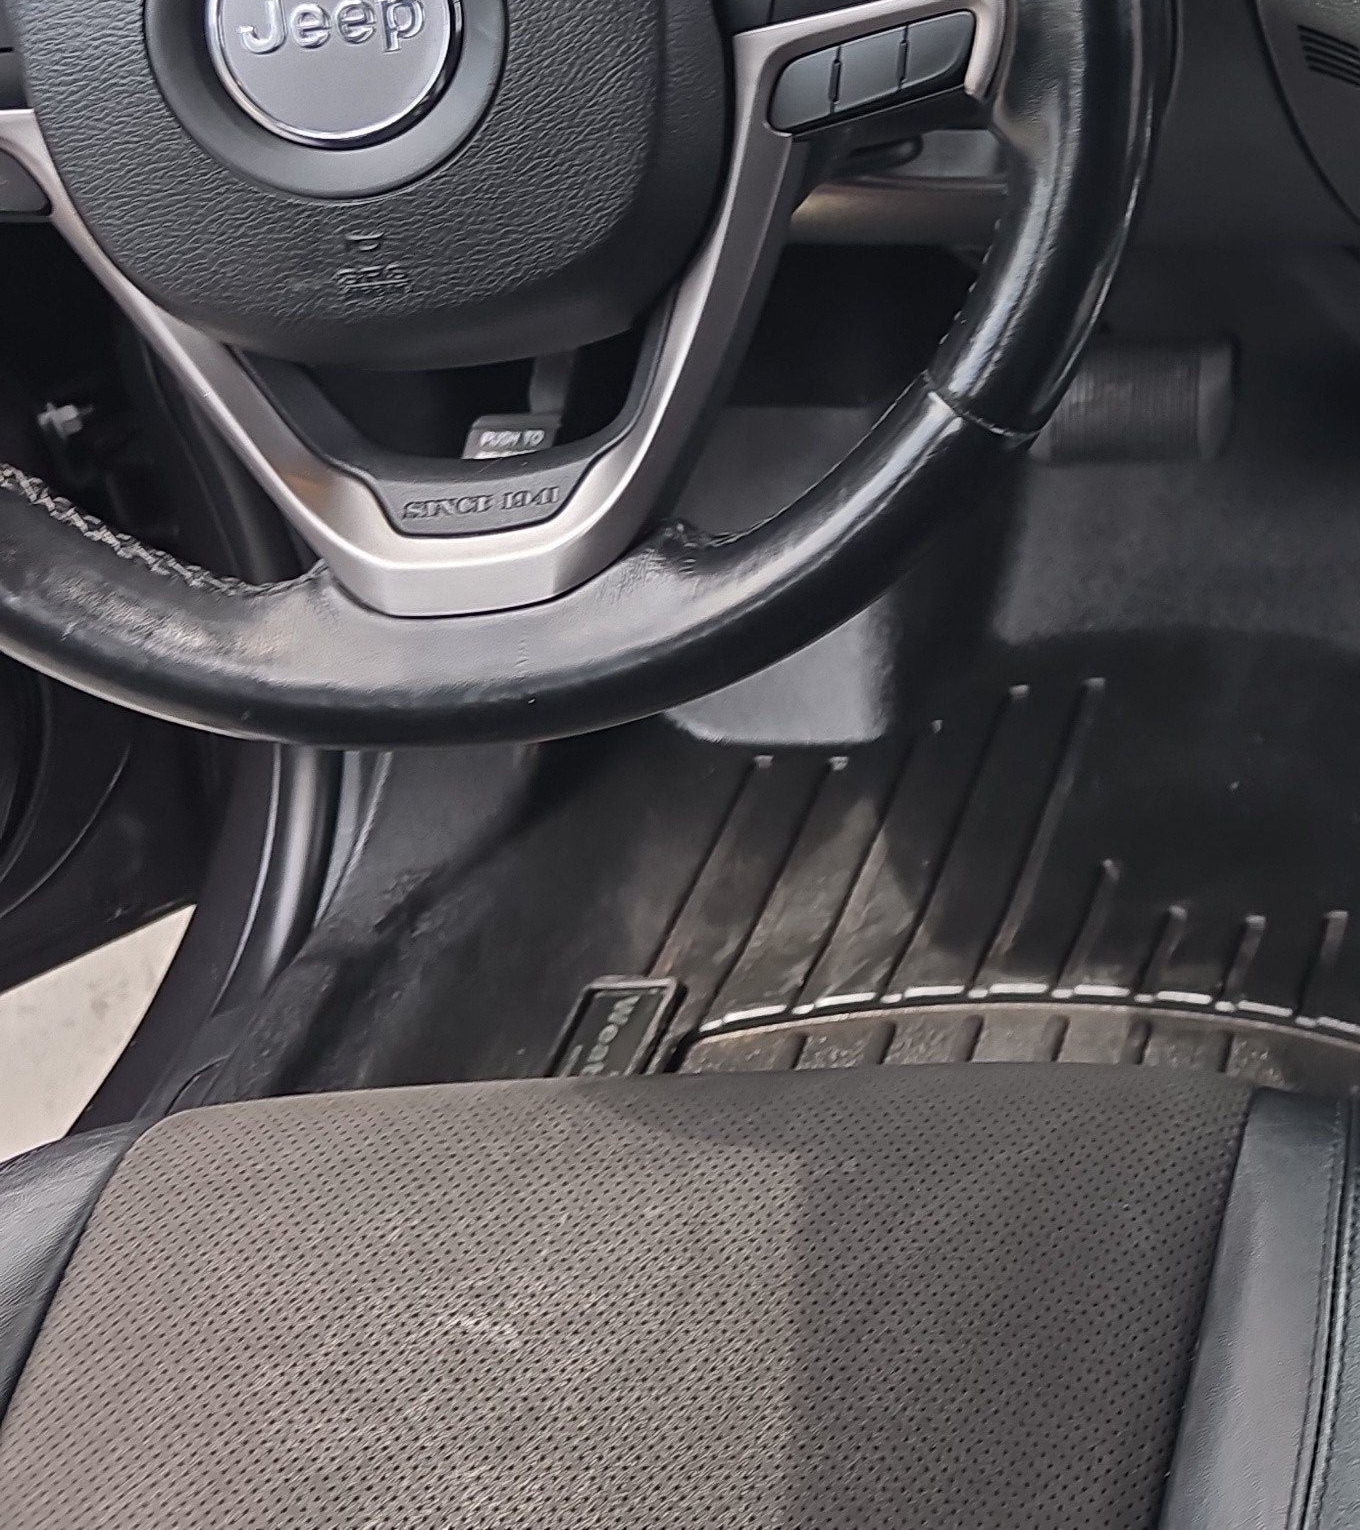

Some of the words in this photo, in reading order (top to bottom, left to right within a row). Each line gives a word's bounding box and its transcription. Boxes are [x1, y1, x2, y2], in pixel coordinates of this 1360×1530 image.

[479, 429, 522, 448] PUSH
[522, 428, 546, 447] TO
[402, 493, 493, 520] SINCE
[500, 486, 560, 510] 1941
